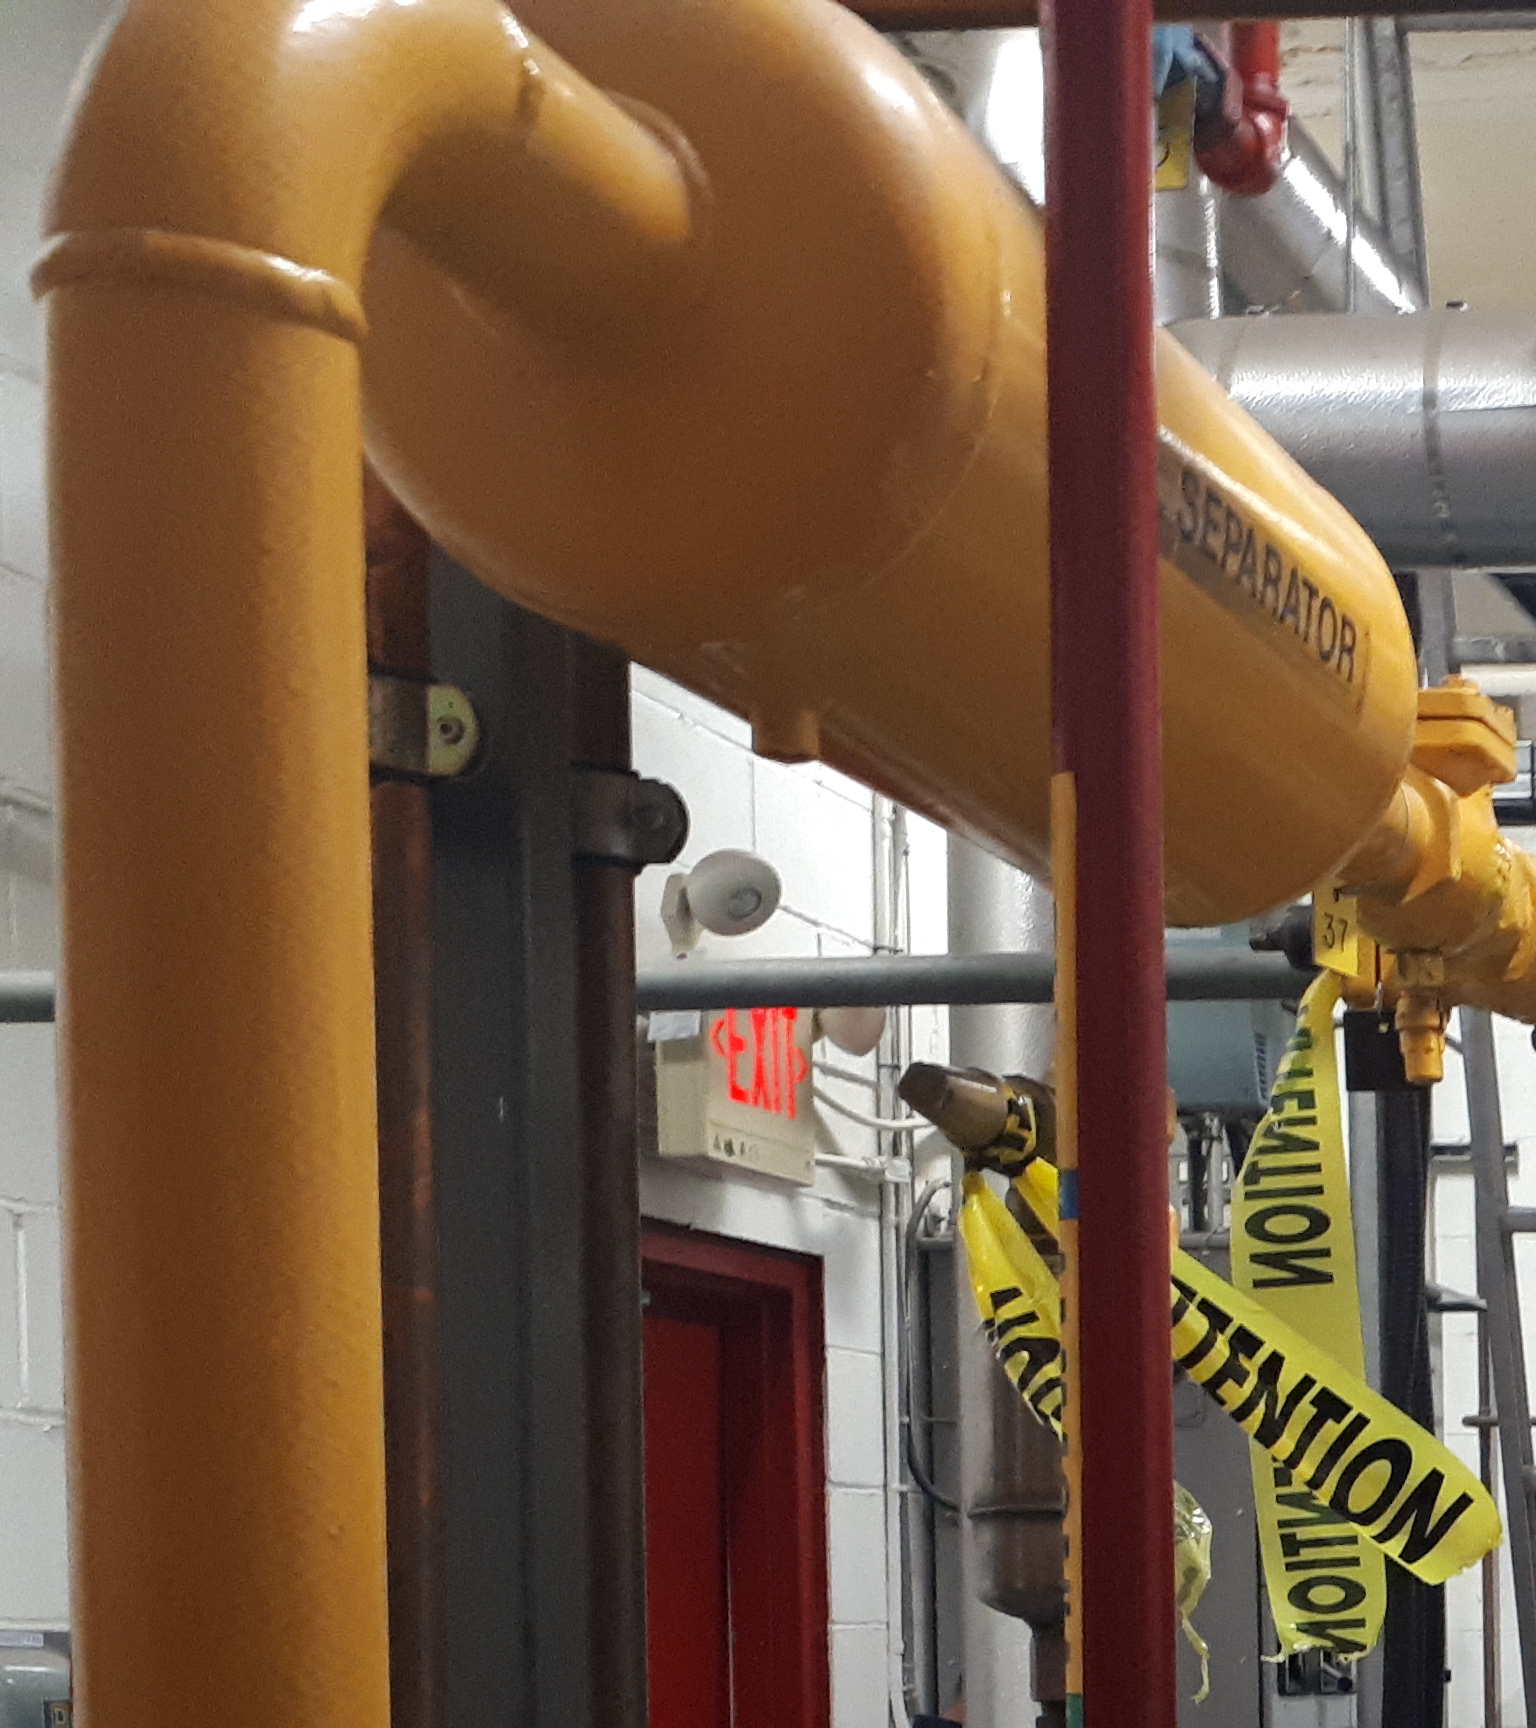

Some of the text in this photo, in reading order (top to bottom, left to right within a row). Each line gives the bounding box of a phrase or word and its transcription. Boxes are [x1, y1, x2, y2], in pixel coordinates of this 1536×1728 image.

[1179, 467, 1358, 682] SEPARATOR
[1322, 911, 1348, 954] 37
[725, 1007, 798, 1119] EXIT
